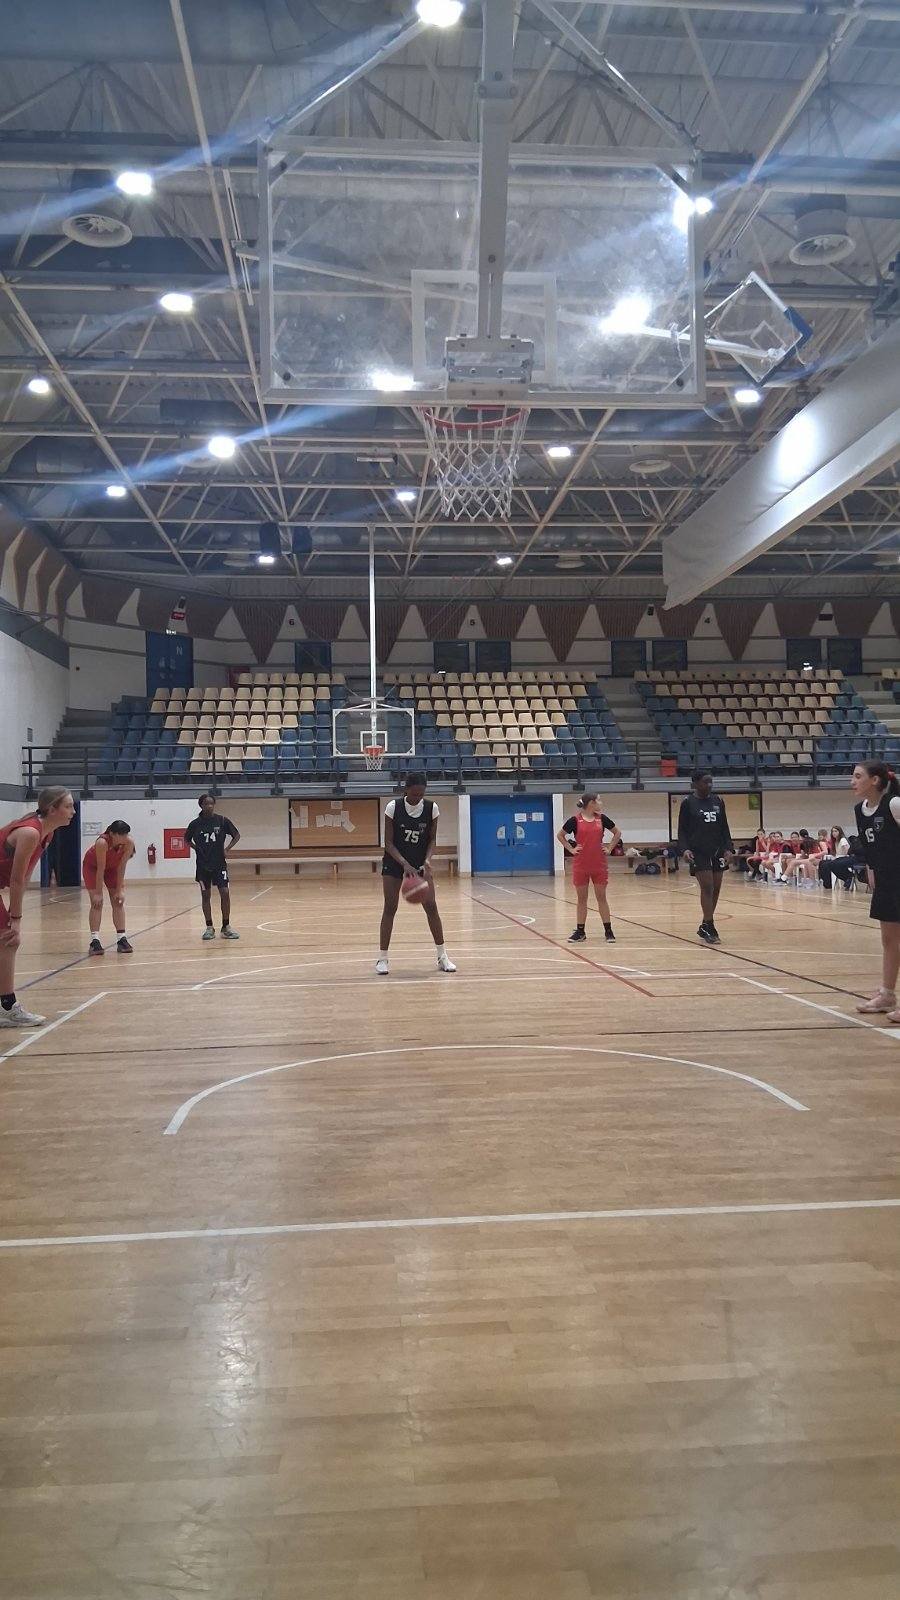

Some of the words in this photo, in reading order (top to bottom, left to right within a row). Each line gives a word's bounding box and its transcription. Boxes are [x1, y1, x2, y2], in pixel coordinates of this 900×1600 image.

[704, 812, 716, 822] 35
[204, 832, 216, 842] 74
[404, 830, 420, 844] 75
